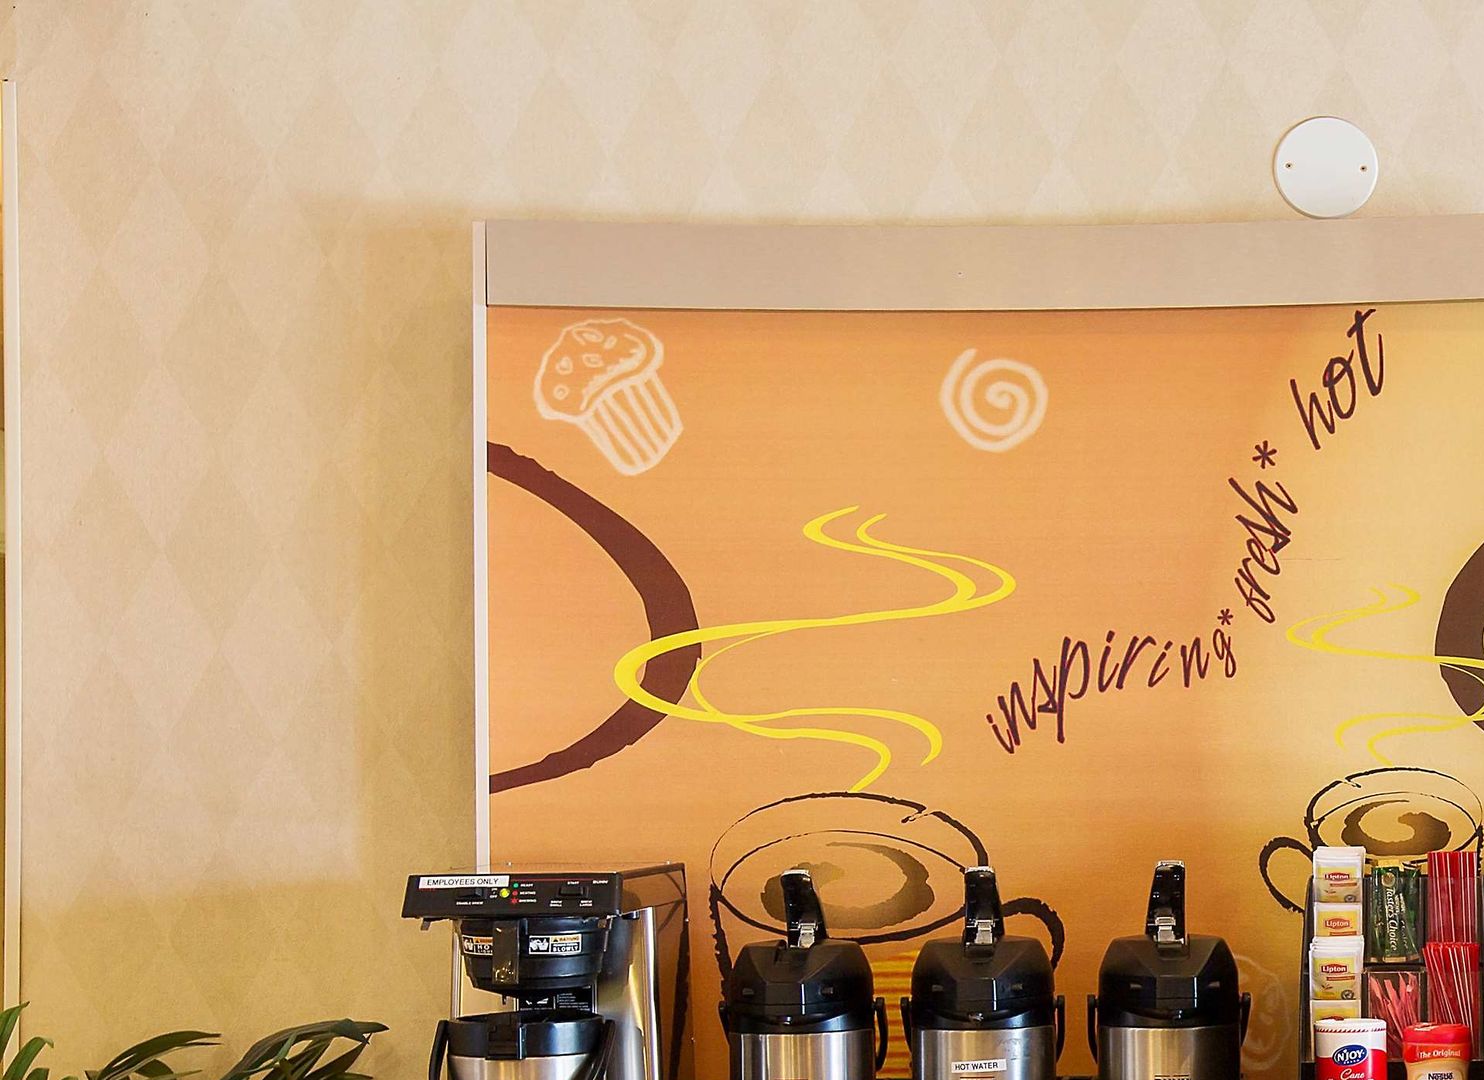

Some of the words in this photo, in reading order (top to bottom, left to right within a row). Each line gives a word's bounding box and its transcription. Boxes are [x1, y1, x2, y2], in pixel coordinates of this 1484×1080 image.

[986, 627, 1236, 755] inspiring
[1228, 476, 1298, 624] fresh
[1289, 308, 1385, 450] hot
[426, 878, 475, 886] EMPLOYEES
[476, 877, 499, 885] ONLY
[1325, 873, 1349, 881] Lipton
[1386, 886, 1397, 919] Taster's
[1326, 920, 1349, 928] Lipton
[1388, 919, 1398, 951] Choice
[1322, 965, 1347, 974] Lipton
[1433, 1049, 1461, 1057] Original
[954, 1063, 970, 1071] HOT
[972, 1061, 998, 1070] WATER
[1340, 1068, 1365, 1080] Cane
